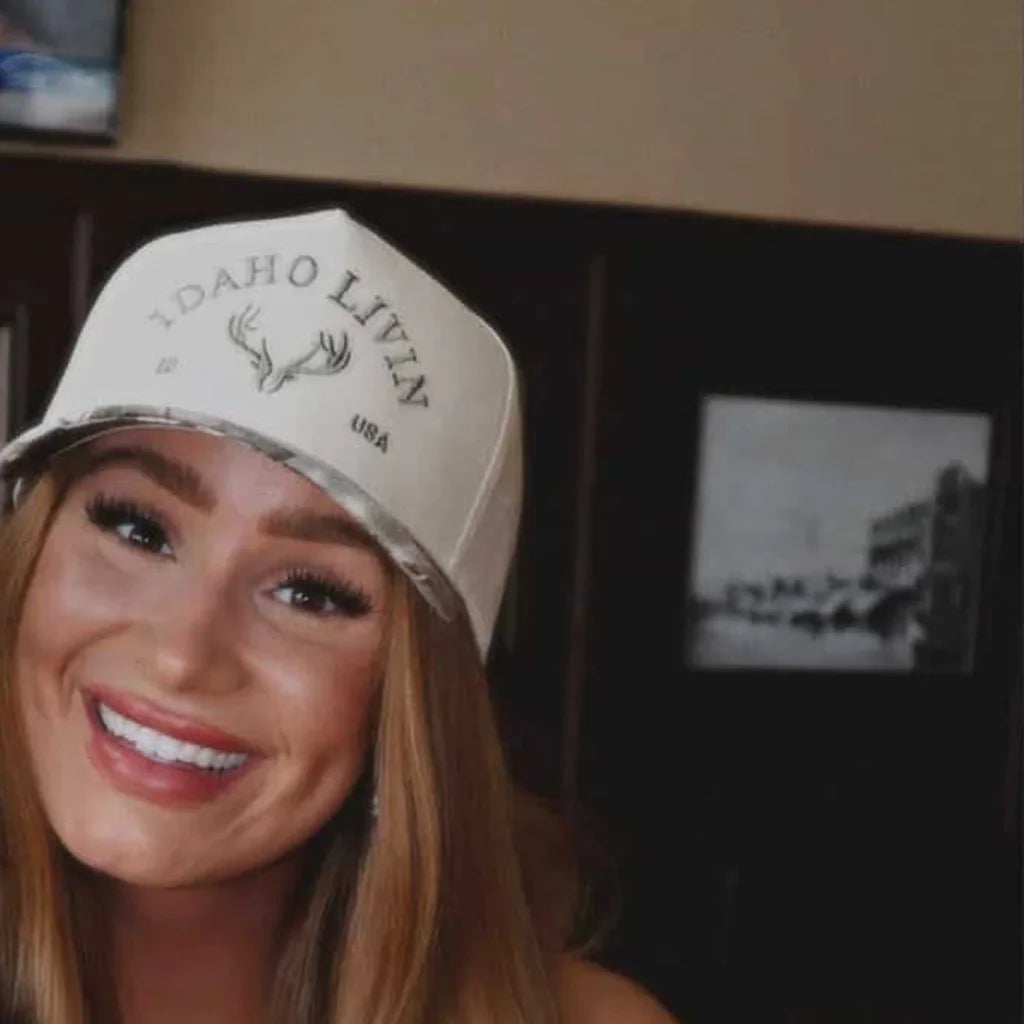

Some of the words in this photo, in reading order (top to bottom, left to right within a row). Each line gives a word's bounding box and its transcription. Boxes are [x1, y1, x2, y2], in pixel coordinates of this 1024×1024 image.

[148, 254, 318, 330] IDAHO
[326, 270, 429, 408] LIVIN
[351, 413, 388, 454] USA
